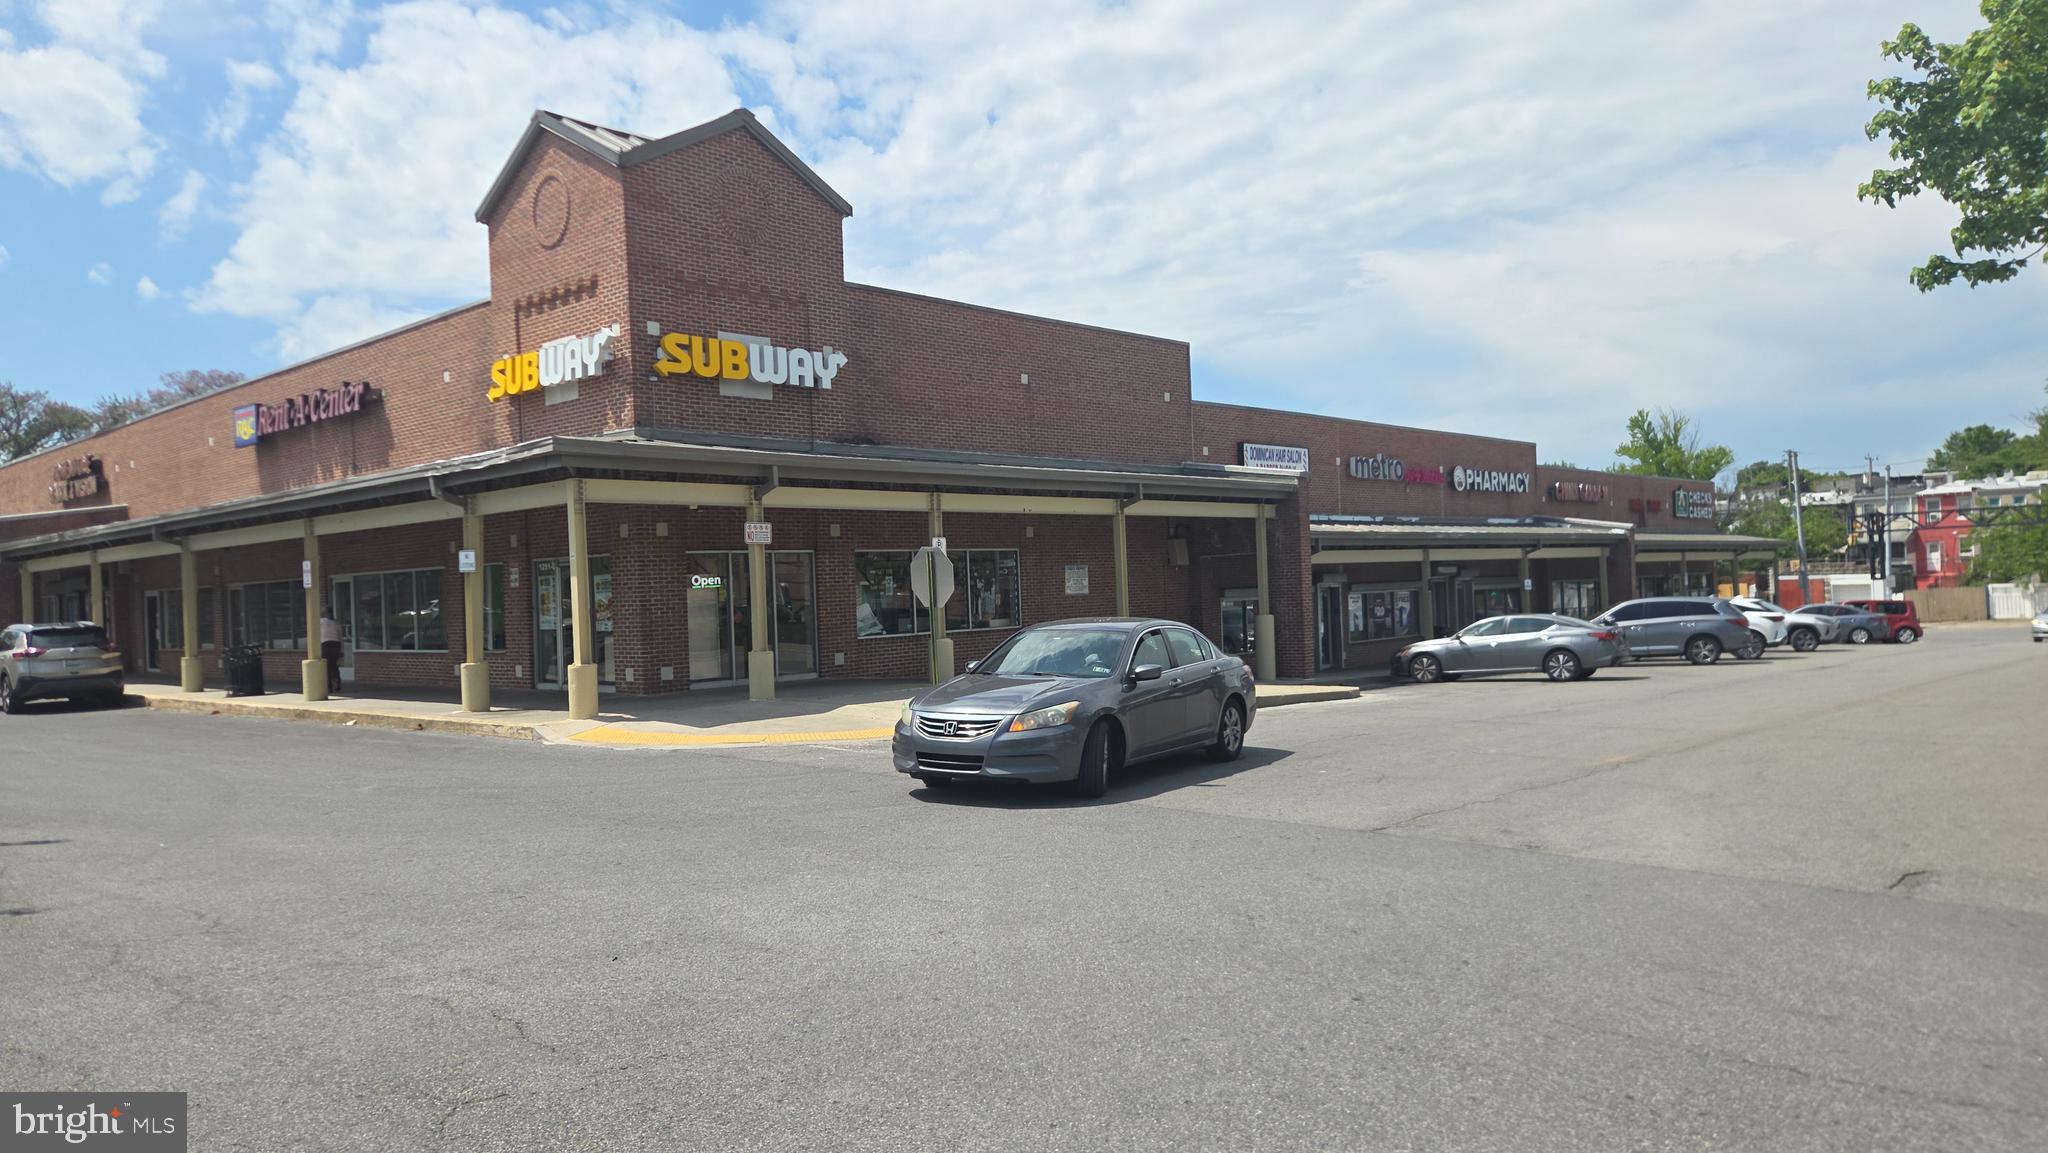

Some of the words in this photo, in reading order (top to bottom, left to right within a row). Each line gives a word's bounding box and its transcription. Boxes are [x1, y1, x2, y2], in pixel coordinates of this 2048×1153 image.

[486, 326, 615, 402] SUBWAY
[653, 332, 849, 389] SUBWAY
[1249, 446, 1274, 462] DOMINICAN
[1274, 448, 1286, 463] HAIR
[1286, 449, 1302, 464] SALON
[1351, 453, 1404, 481] metro
[1466, 469, 1530, 493] PHARMACY
[1689, 490, 1712, 504] CHECKS
[1689, 506, 1713, 519] CASHED
[691, 575, 721, 588] Open
